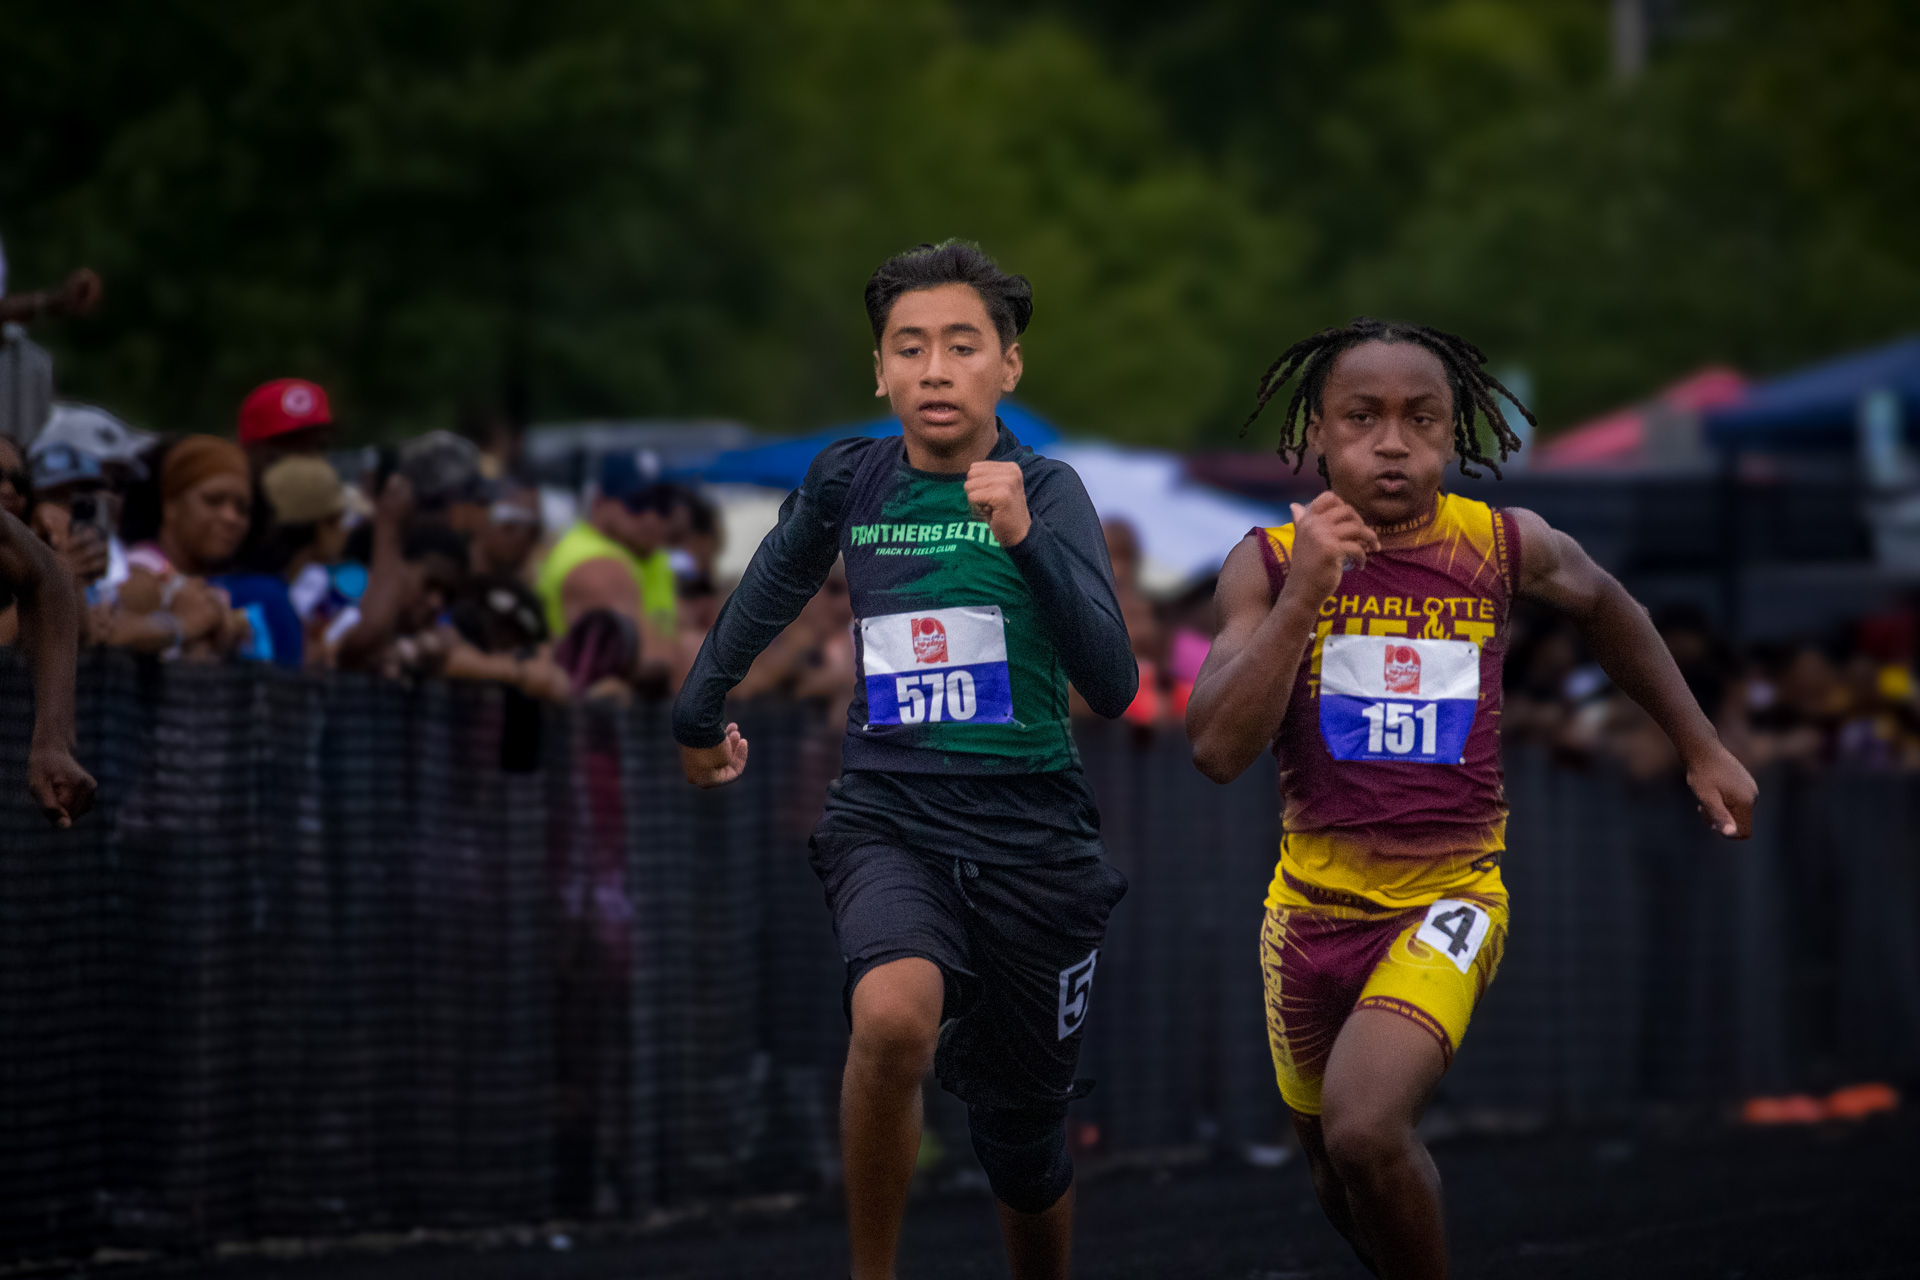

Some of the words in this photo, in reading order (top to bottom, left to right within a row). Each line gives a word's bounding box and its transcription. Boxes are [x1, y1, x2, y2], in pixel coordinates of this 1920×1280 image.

[851, 524, 943, 547] PANTHERS
[875, 547, 902, 556] TRACK
[911, 546, 935, 556] FIELD
[935, 544, 958, 554] CLUB
[1319, 595, 1495, 619] CHARLOTTE
[895, 669, 977, 725] 570
[1361, 702, 1438, 755] 151
[1431, 905, 1478, 958] 4
[1063, 959, 1093, 1029] 5
